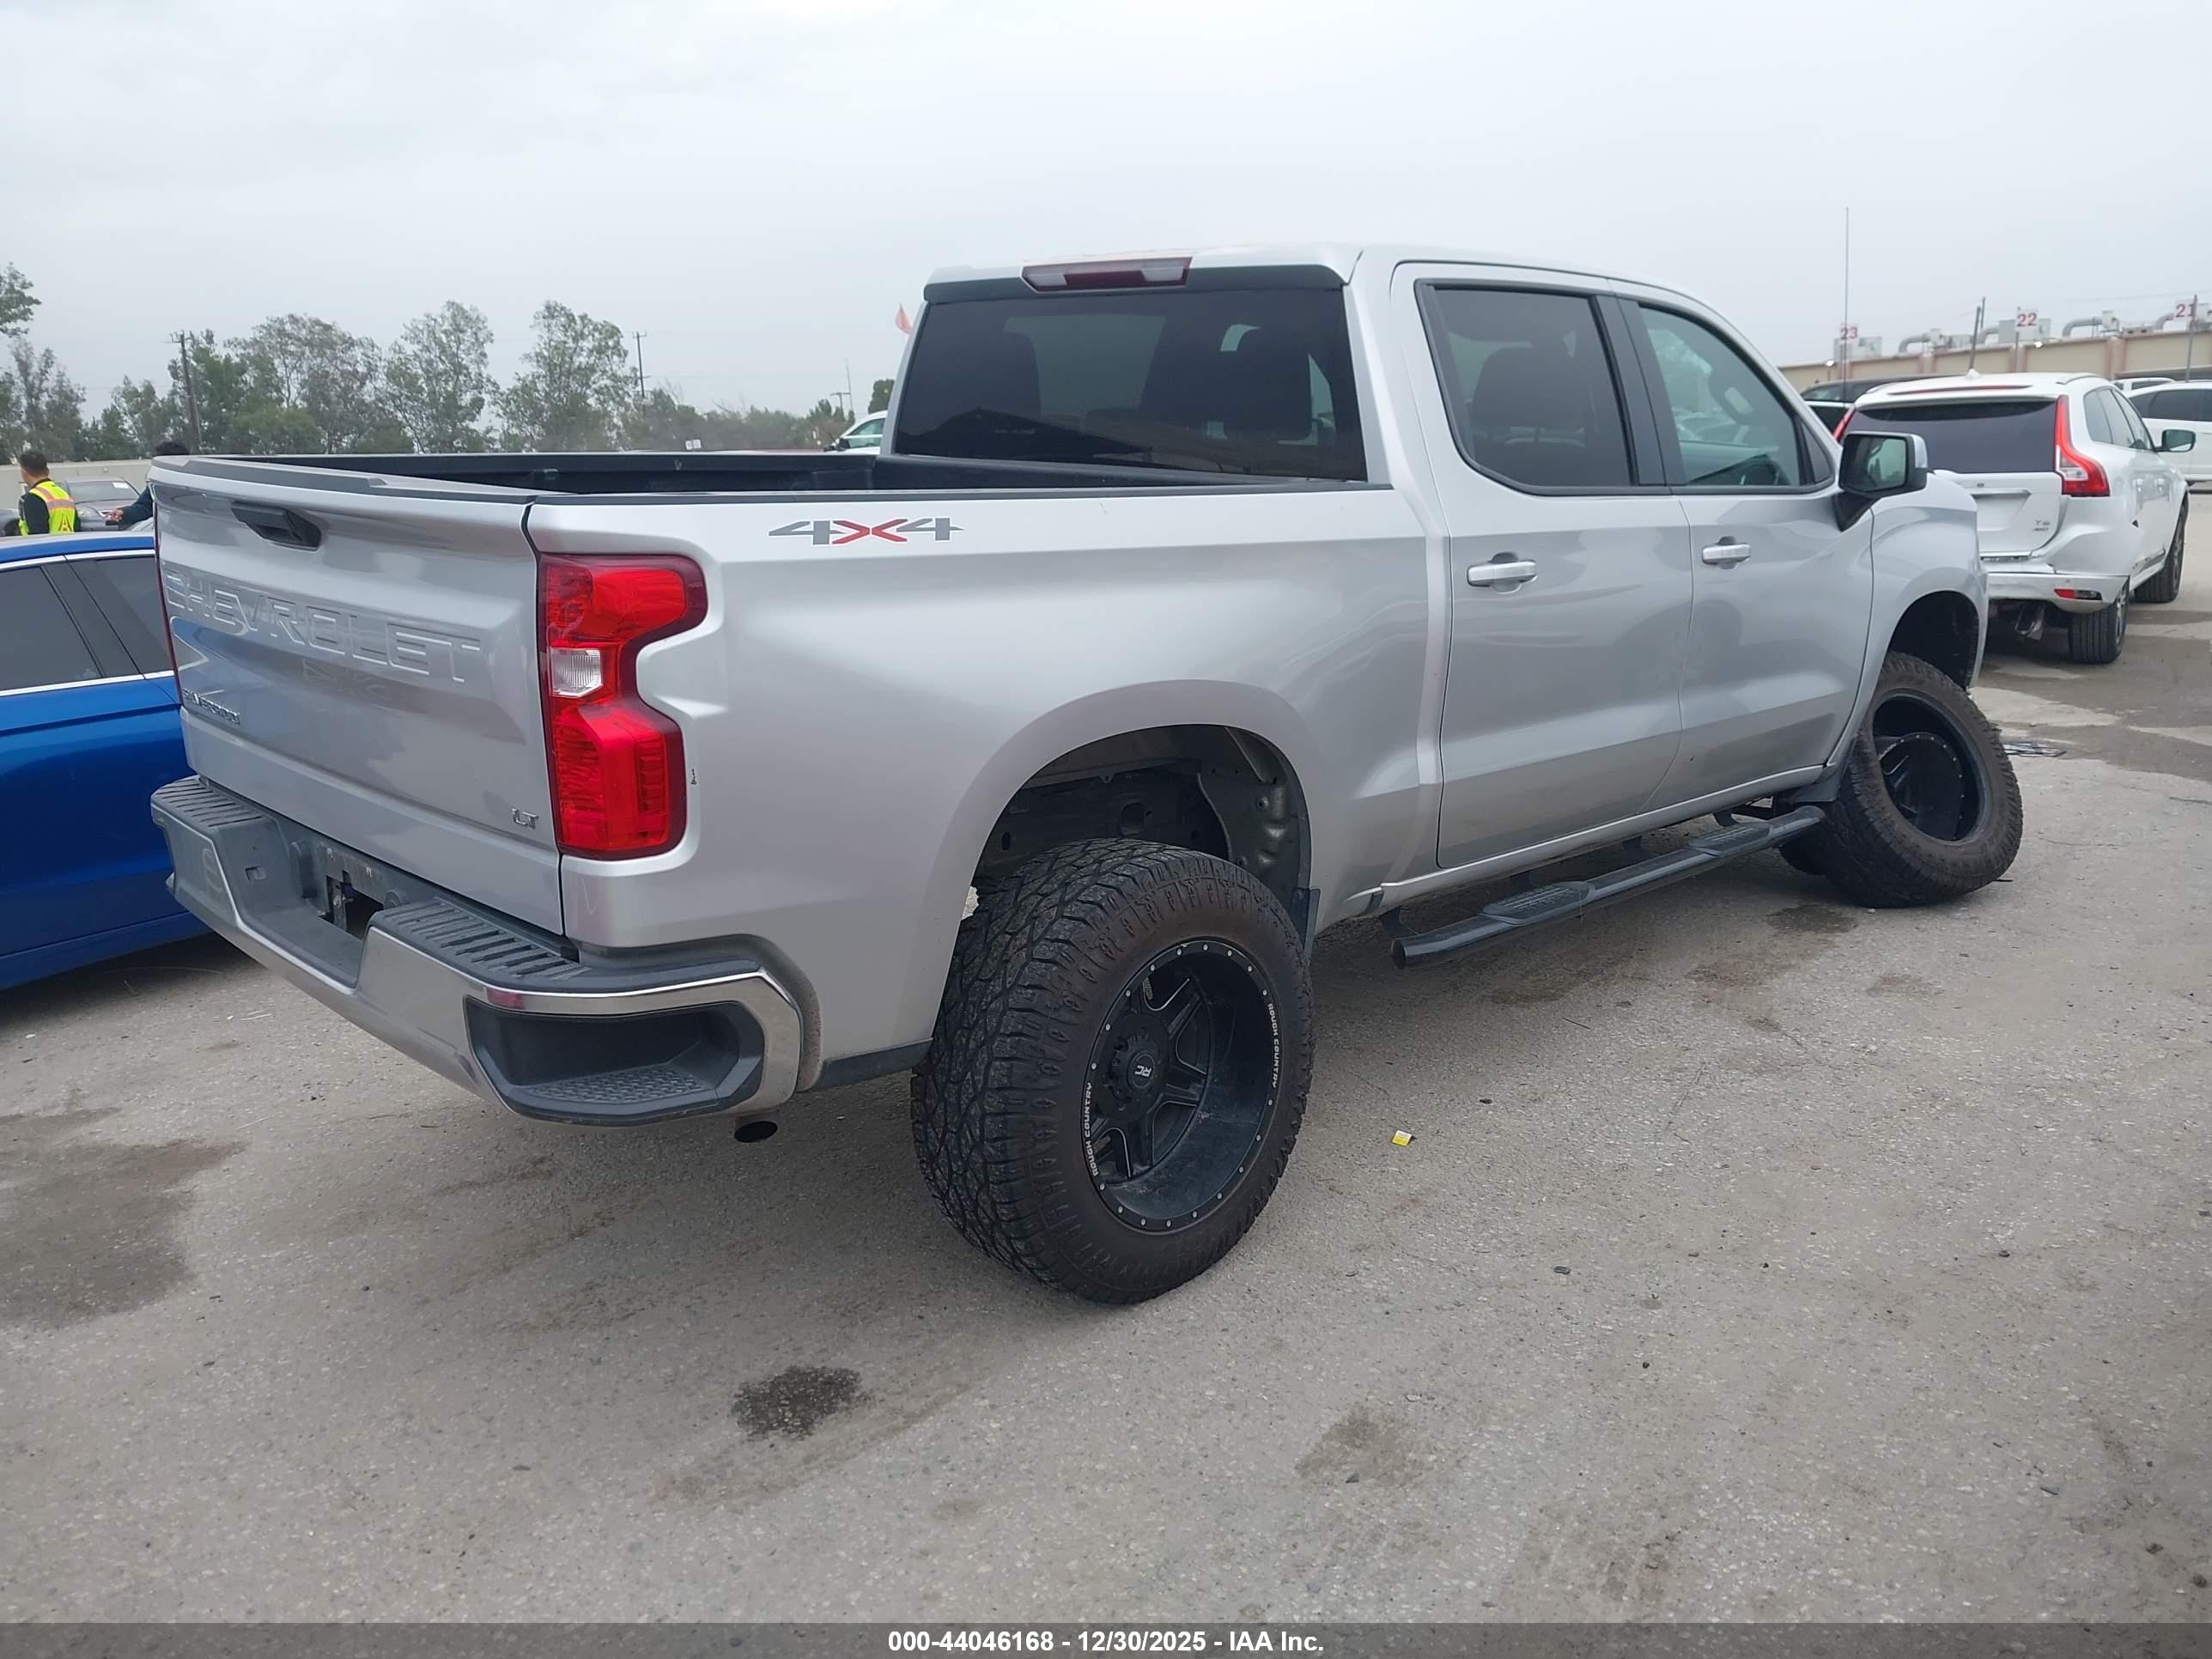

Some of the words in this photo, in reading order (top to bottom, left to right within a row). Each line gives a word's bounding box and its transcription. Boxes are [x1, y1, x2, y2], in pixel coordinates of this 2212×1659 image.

[2017, 313, 2038, 327] 22
[2176, 303, 2196, 318] 21
[1840, 326, 1858, 340] 23
[163, 567, 481, 684] CHEVROLET
[511, 808, 539, 830] LT
[1267, 1003, 1279, 1036] ROUGH
[1134, 1065, 1152, 1077] RC
[1084, 1082, 1093, 1138] COUNTRY
[1085, 1140, 1099, 1176] ROUGH
